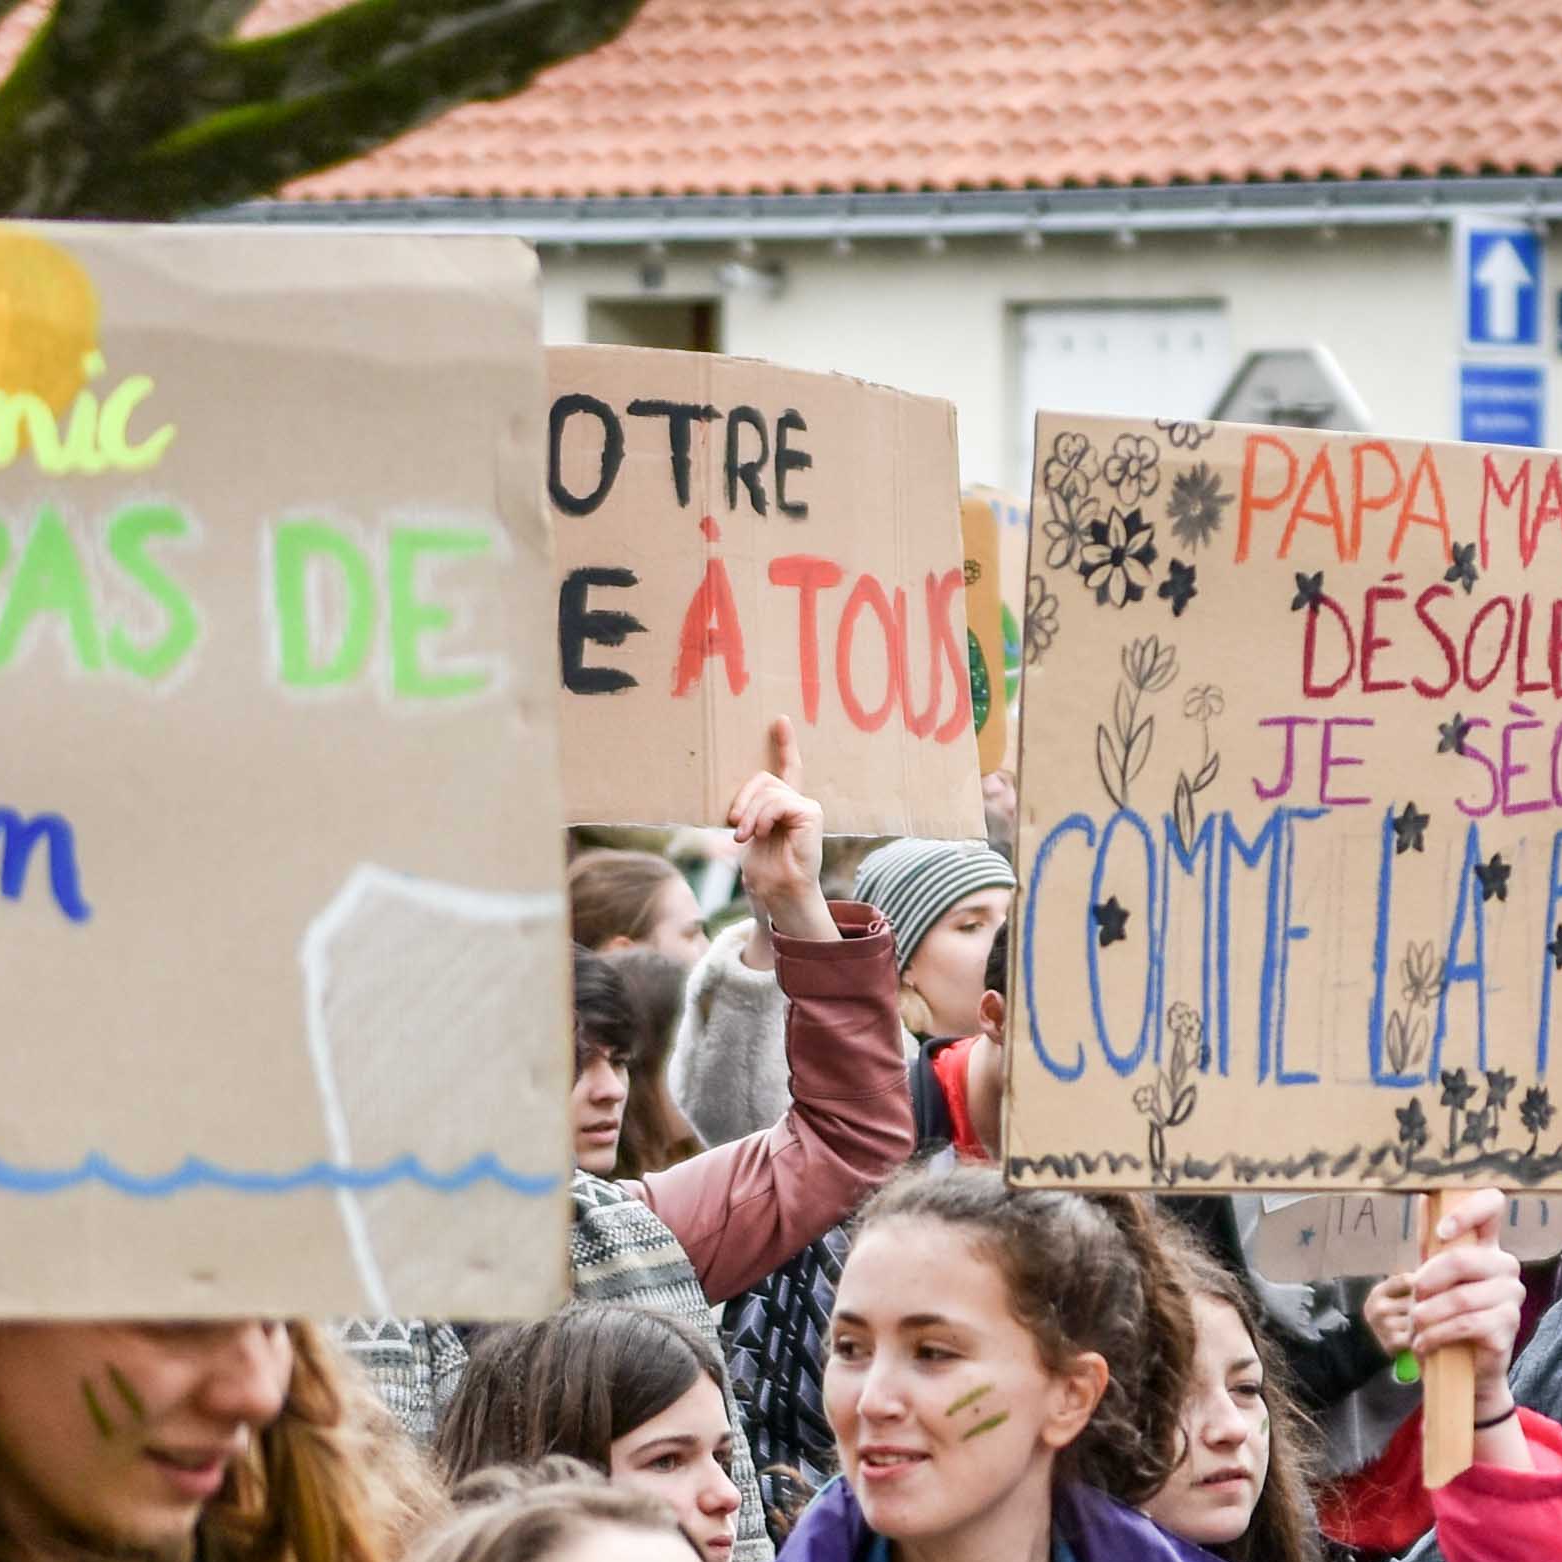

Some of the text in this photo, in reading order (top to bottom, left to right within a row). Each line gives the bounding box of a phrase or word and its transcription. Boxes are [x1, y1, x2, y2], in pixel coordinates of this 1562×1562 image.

[1233, 434, 1454, 564] PAPA
[273, 517, 497, 699] DE
[767, 553, 974, 745] TOUS
[1252, 715, 1377, 807] JE
[1023, 804, 1333, 1087] COMME
[1368, 802, 1487, 1089] LA
